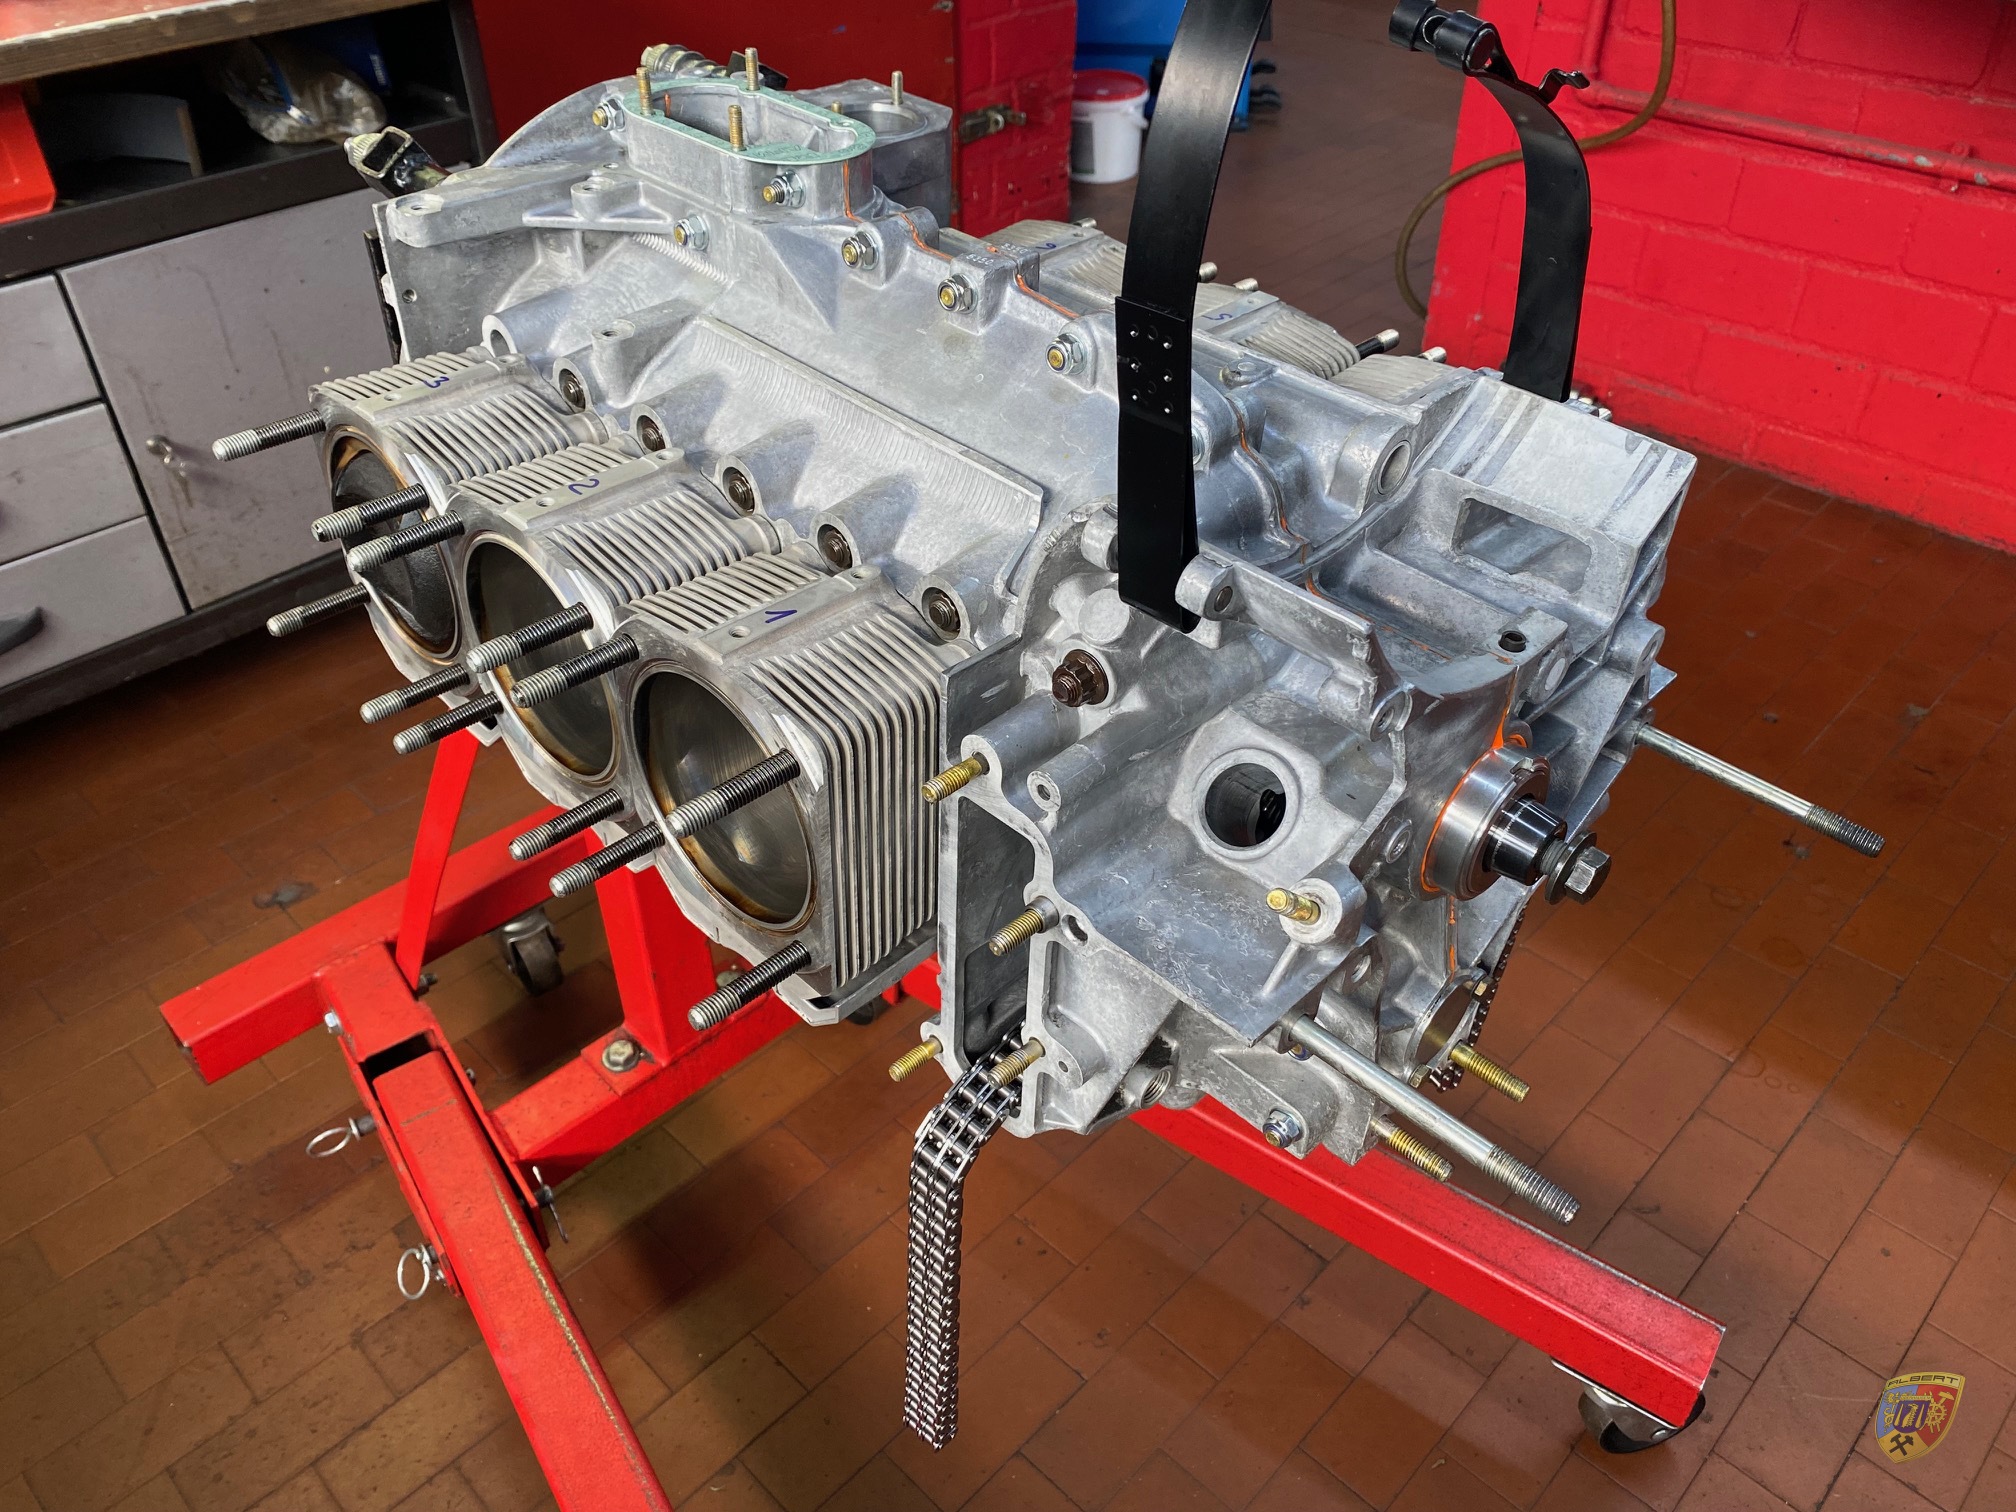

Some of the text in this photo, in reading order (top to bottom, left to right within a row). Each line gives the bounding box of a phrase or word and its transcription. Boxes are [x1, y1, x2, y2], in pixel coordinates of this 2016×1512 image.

[423, 376, 450, 389] 3
[567, 478, 600, 496] 2
[764, 609, 798, 624] 1
